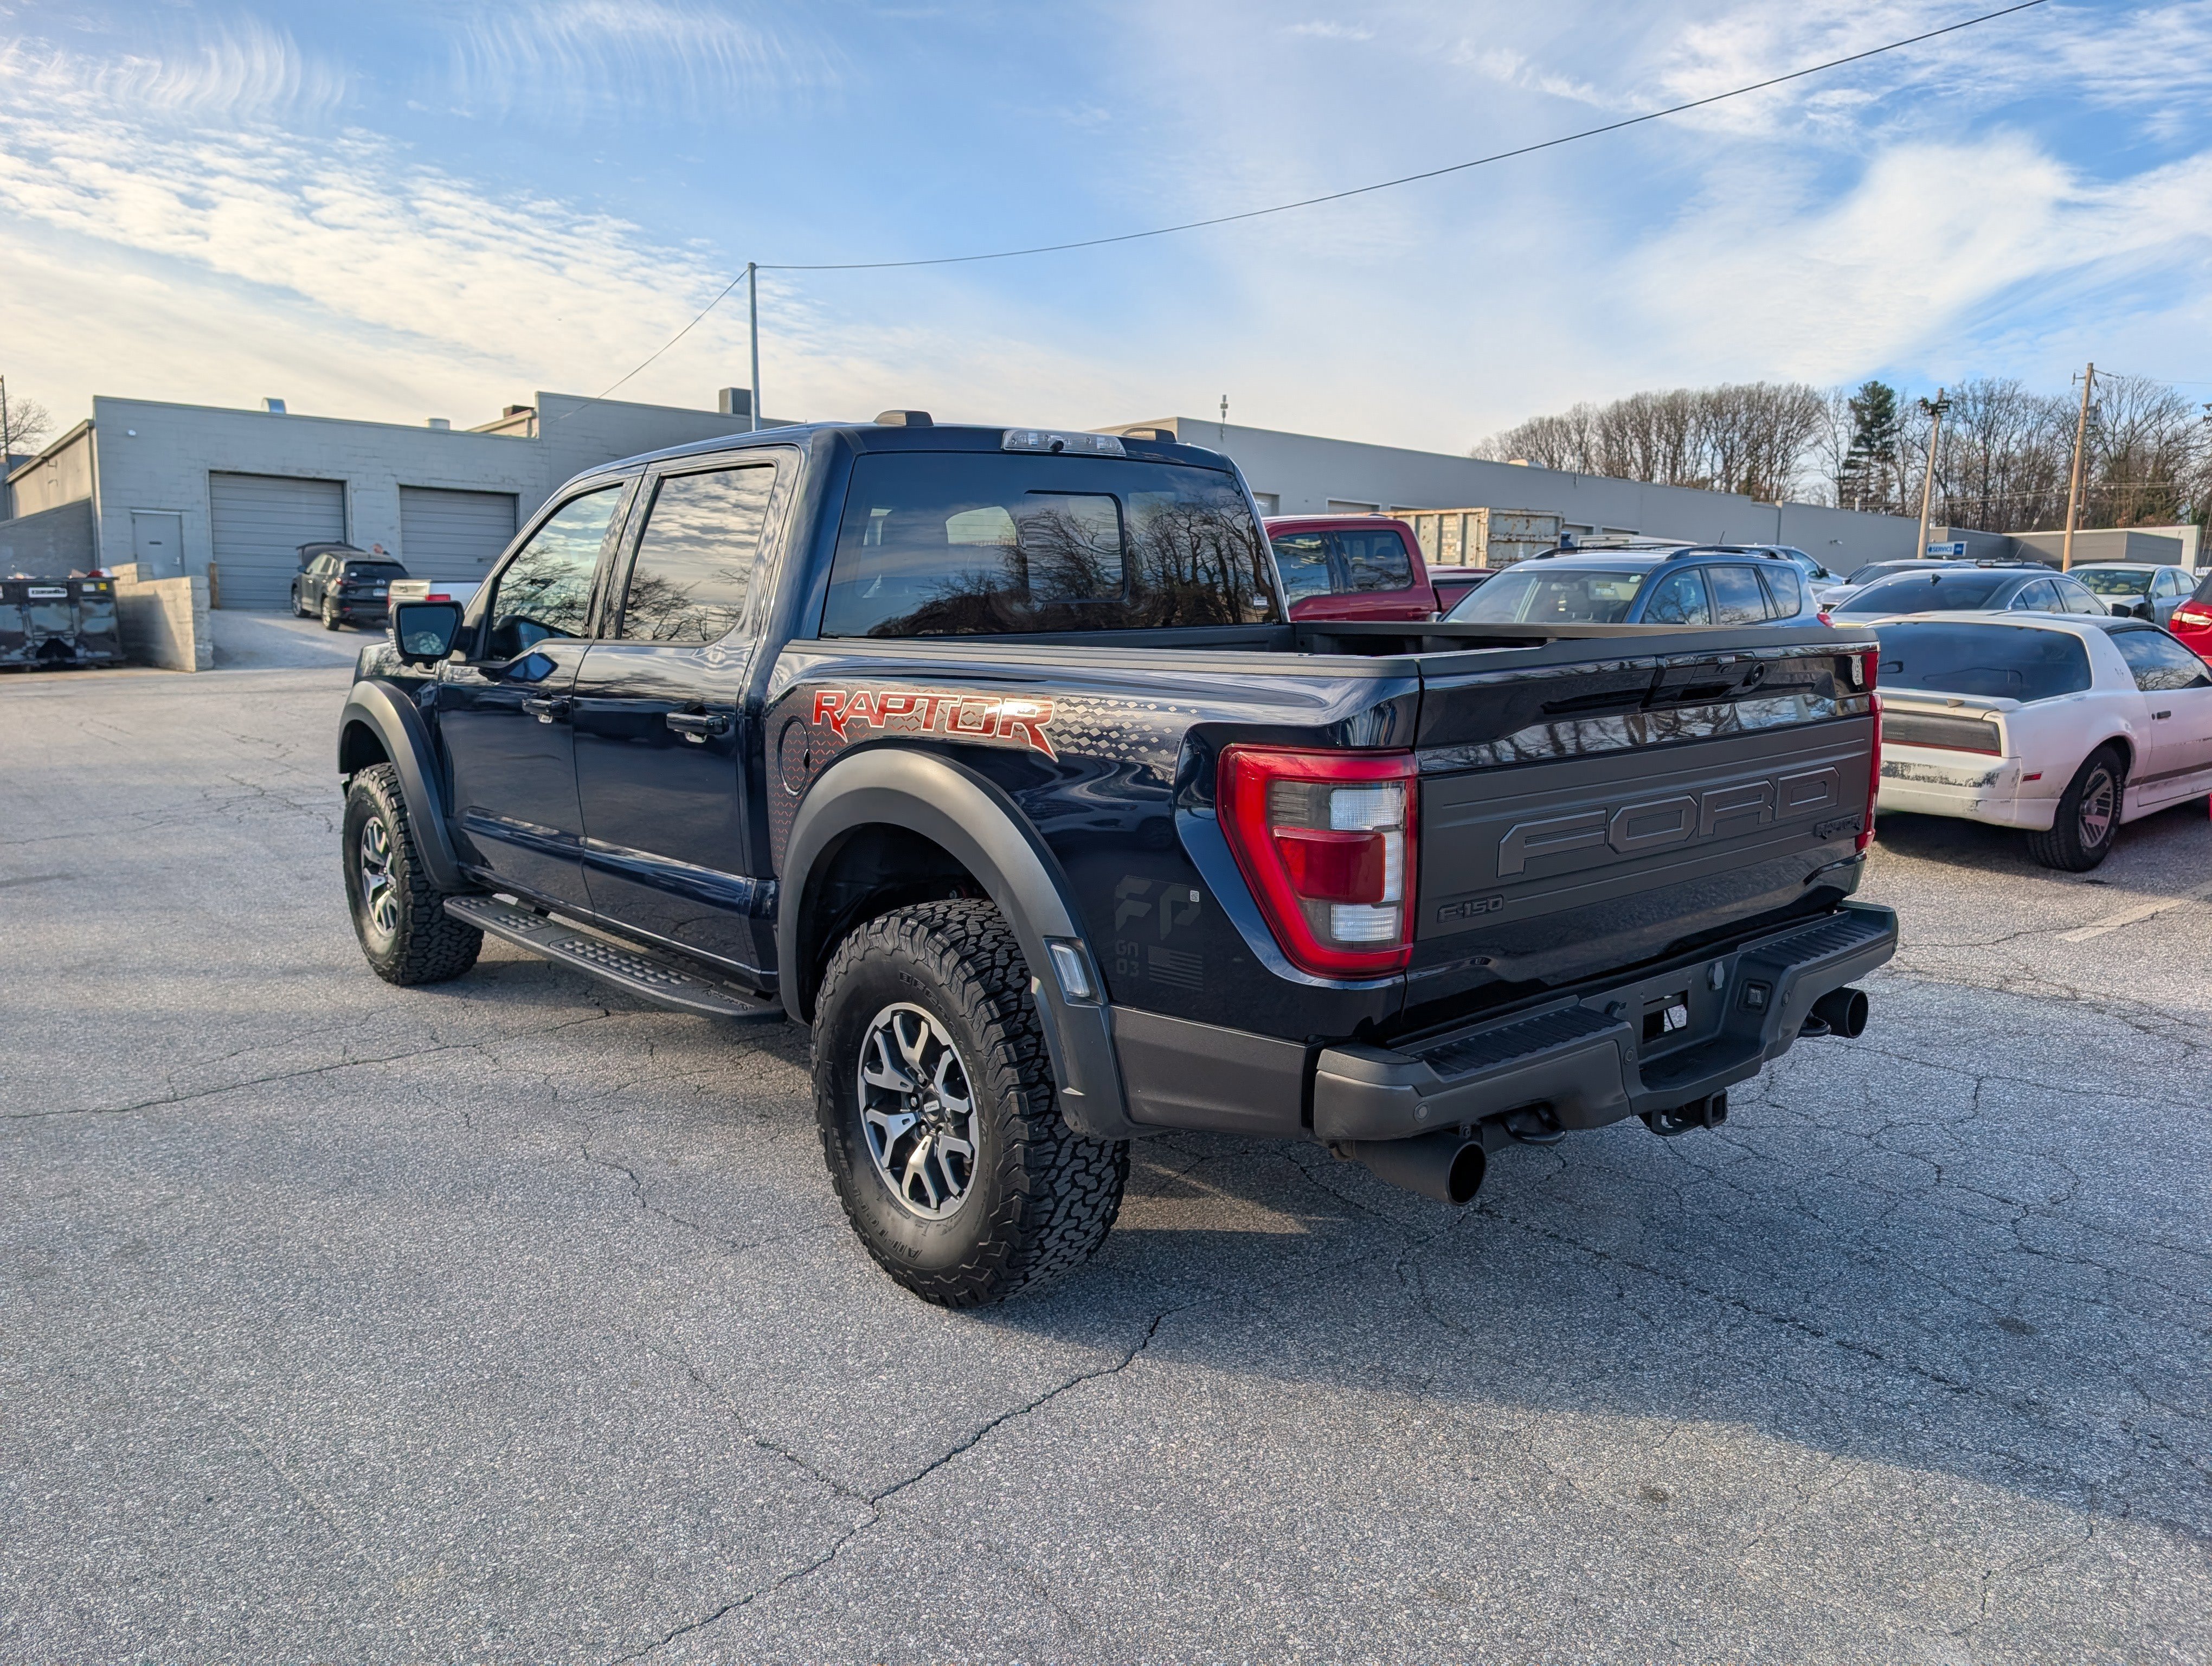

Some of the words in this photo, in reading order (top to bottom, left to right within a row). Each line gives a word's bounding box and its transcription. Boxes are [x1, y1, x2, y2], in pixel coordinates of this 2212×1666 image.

[813, 690, 1059, 763] RAPTOR
[1497, 766, 1840, 879] FORD
[1437, 896, 1503, 922] F-150
